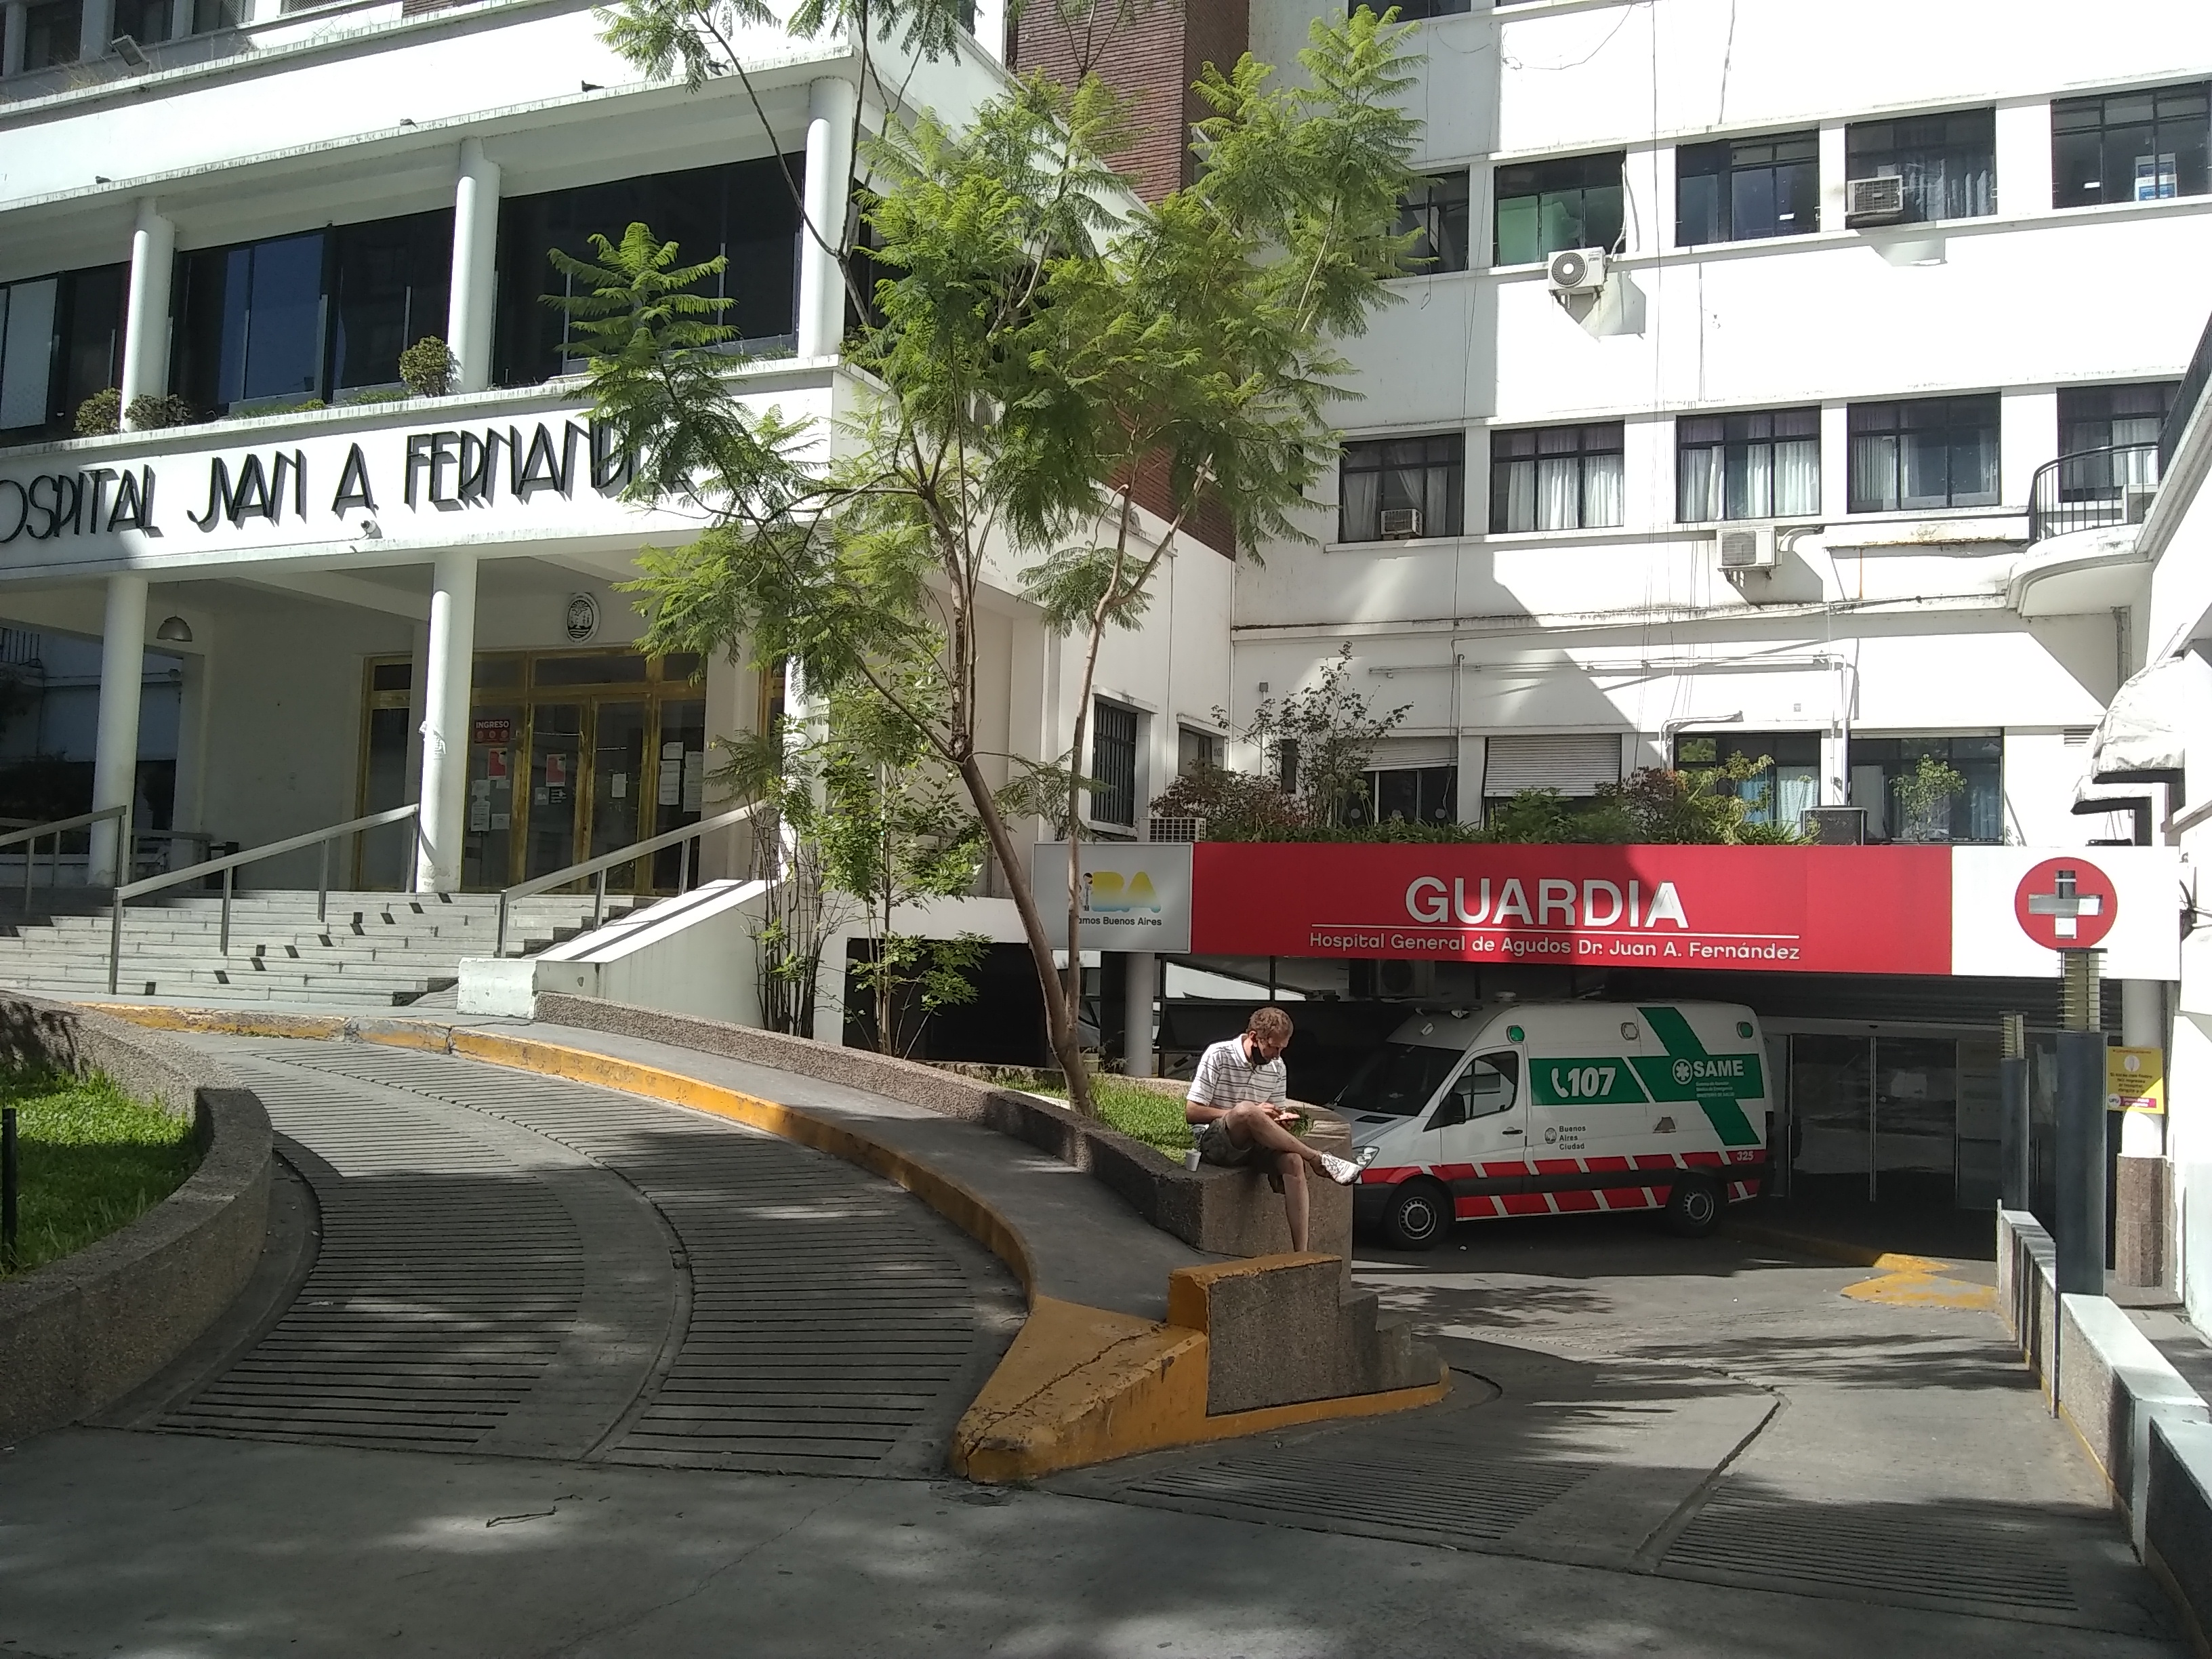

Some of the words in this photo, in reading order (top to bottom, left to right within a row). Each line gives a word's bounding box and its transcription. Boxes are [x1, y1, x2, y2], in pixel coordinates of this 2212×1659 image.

[0, 464, 157, 543] OSPITAL
[405, 412, 678, 506] FERNAND
[1405, 876, 1689, 928] GUARDIA
[1078, 917, 1101, 926] amos
[1103, 916, 1135, 926] Buenos
[1137, 917, 1162, 926] Aires
[1309, 932, 1385, 951] Hospital
[1391, 933, 1466, 951] General
[1471, 935, 1495, 952] de
[1500, 937, 1572, 957] Agudos
[1578, 939, 1603, 956] Dr.
[1609, 939, 1657, 957] Juan
[1662, 941, 1683, 958] A.
[1689, 941, 1801, 960] Fernández
[1567, 1067, 1616, 1097] 107
[1693, 1059, 1745, 1078] SAME
[1736, 1151, 1754, 1162] 325
